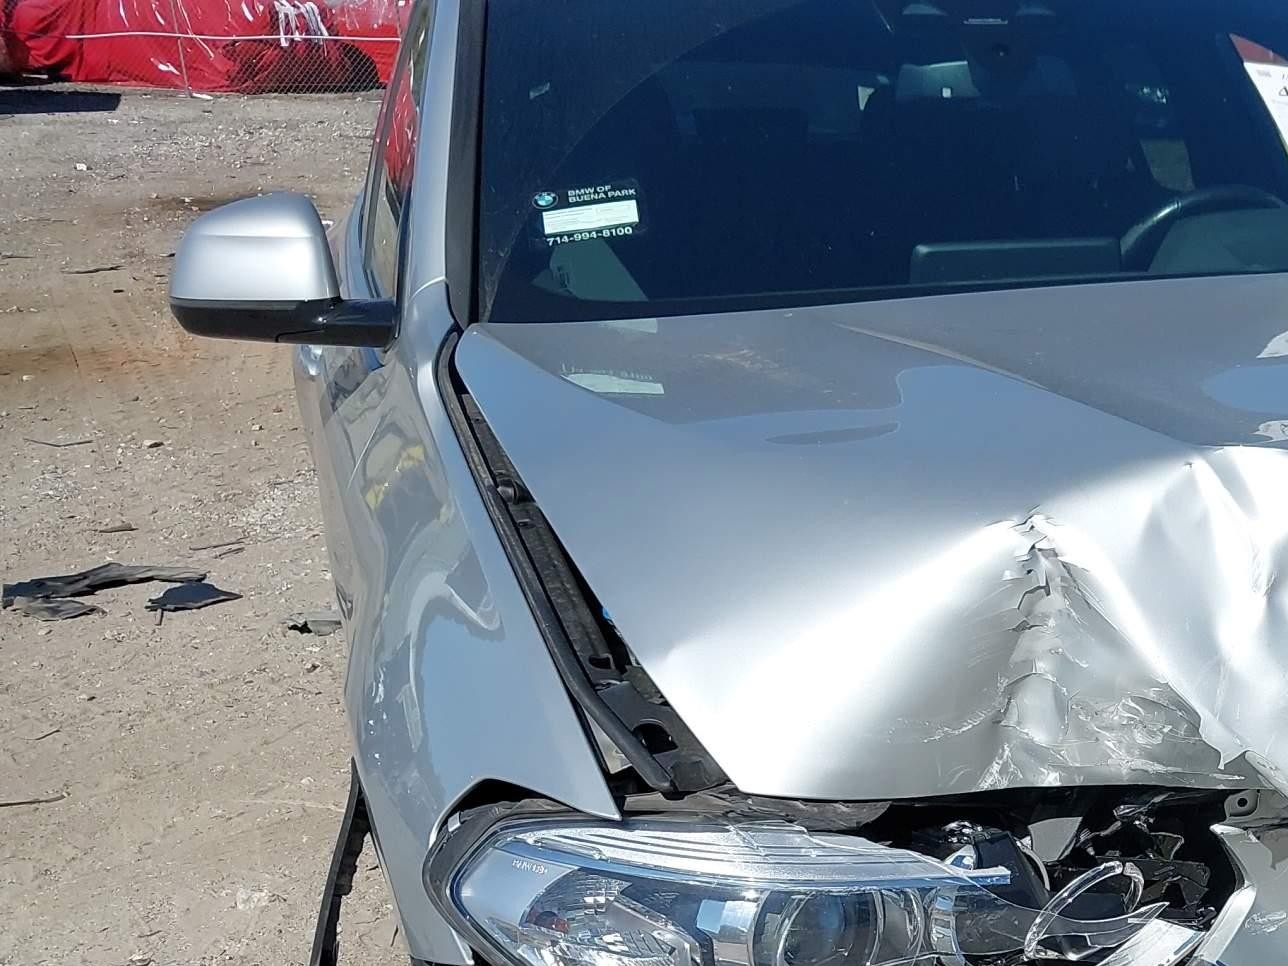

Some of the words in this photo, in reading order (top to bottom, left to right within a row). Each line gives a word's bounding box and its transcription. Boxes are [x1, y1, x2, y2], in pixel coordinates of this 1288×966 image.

[568, 188, 594, 196] BMW
[596, 185, 612, 193] OF
[568, 193, 607, 203] BUENA
[608, 188, 637, 199] PARK
[546, 226, 633, 246] 714-994-8100
